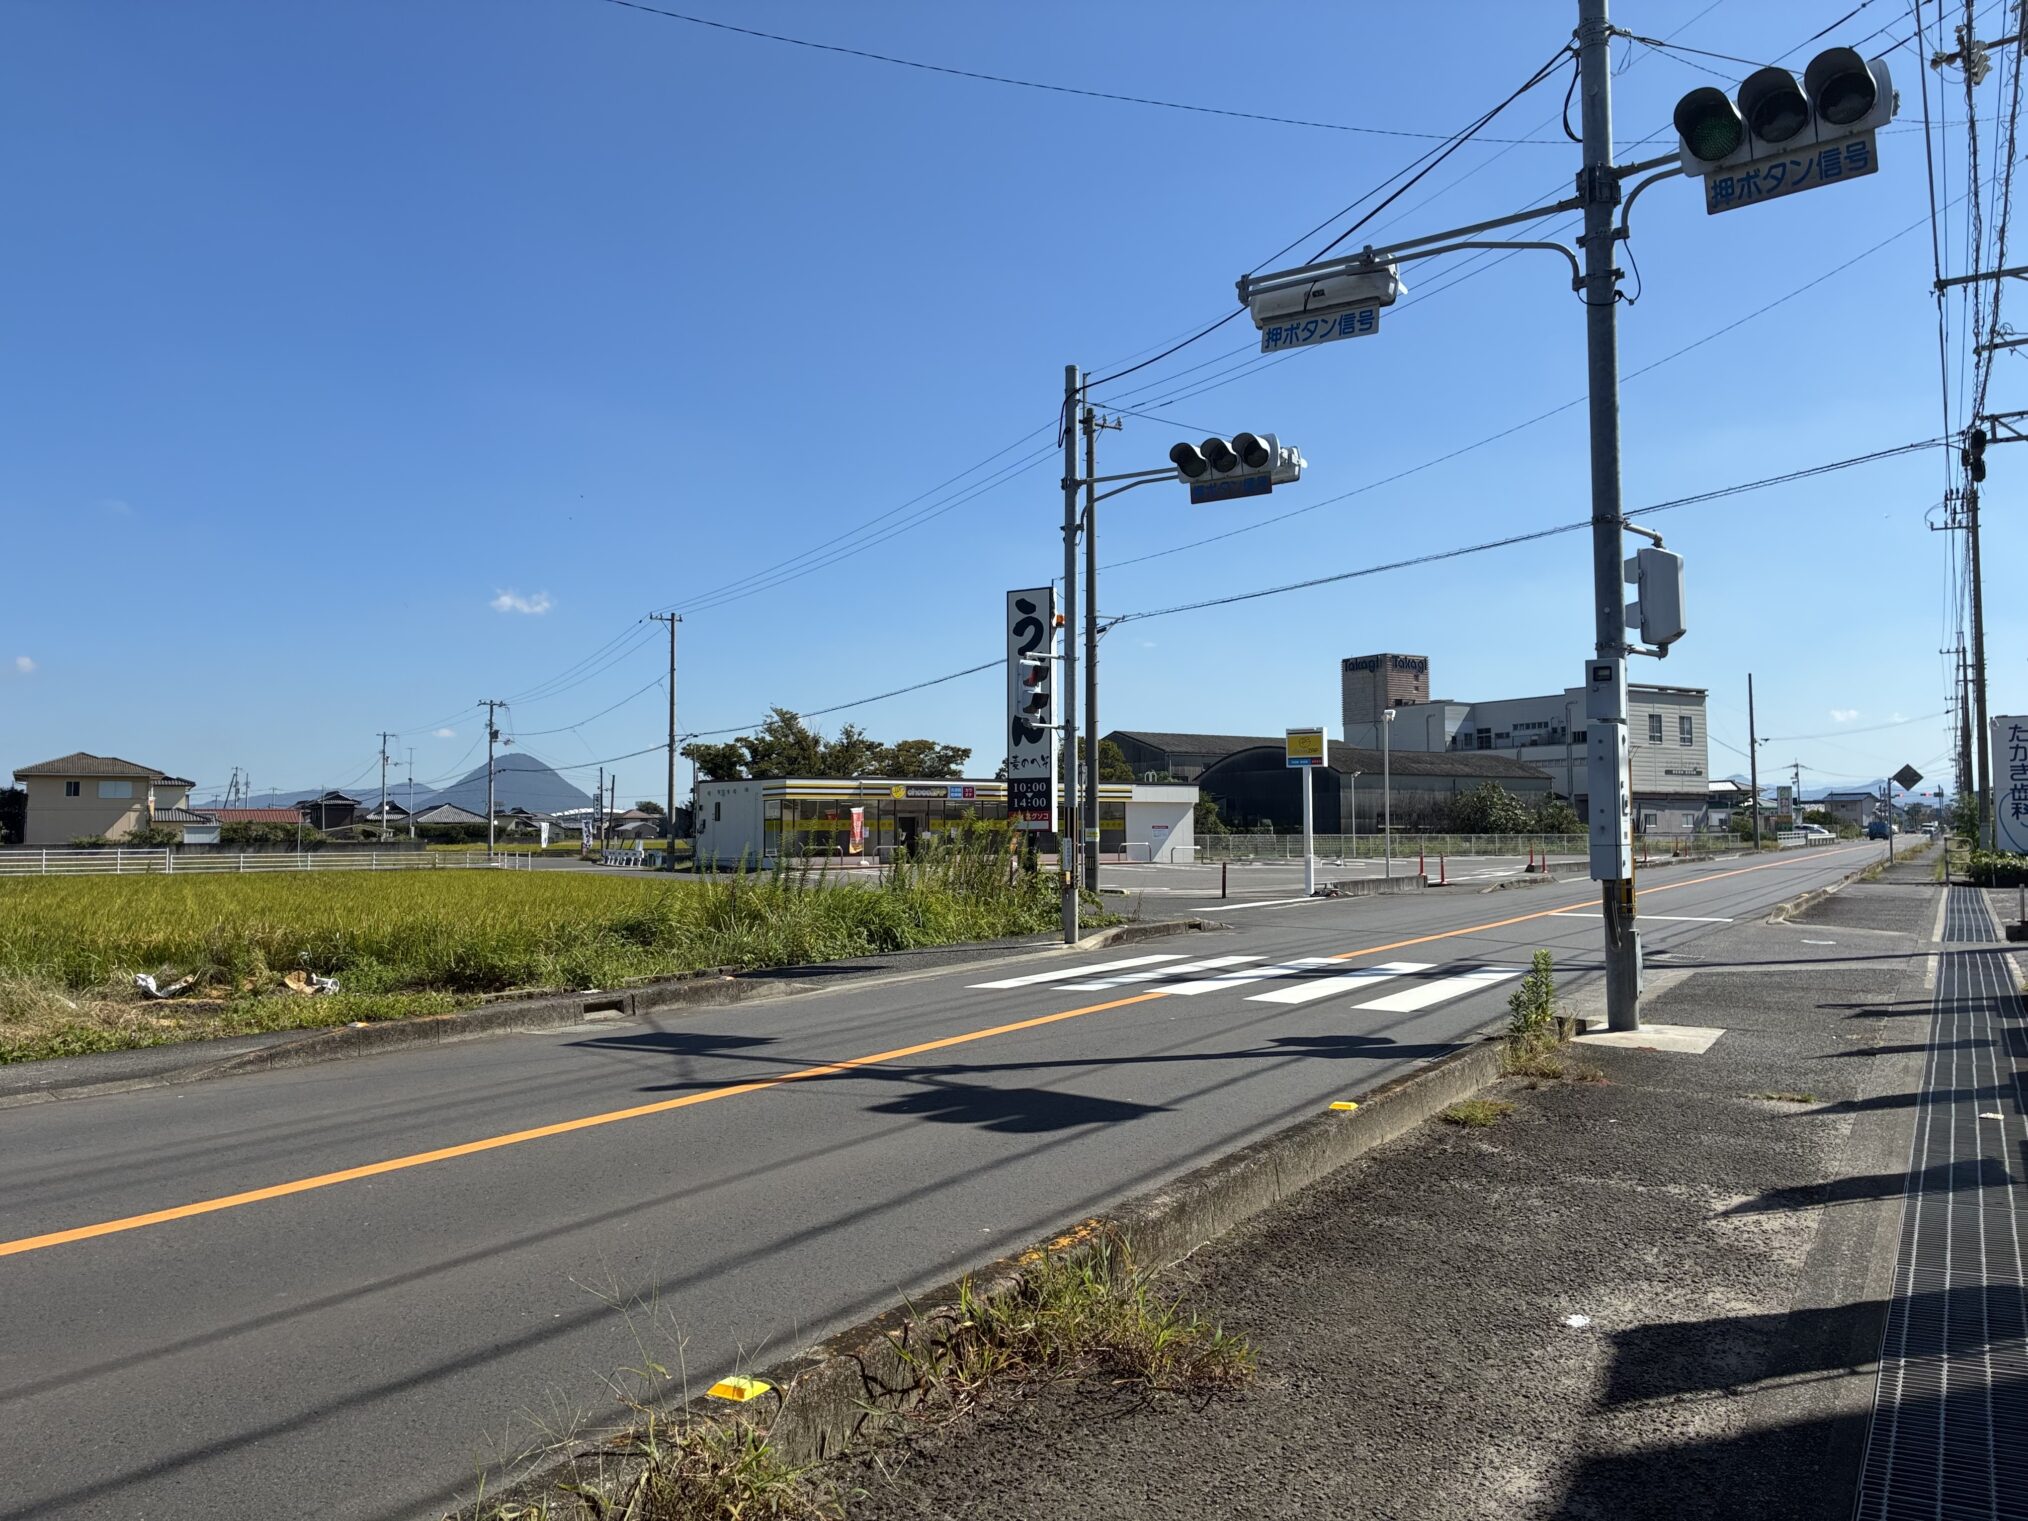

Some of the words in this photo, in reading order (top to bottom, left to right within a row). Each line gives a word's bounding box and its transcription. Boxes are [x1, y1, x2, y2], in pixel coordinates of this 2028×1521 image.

[1710, 140, 1870, 209] 押ボタン信号
[1265, 309, 1375, 349] 押ボタン信号
[1012, 598, 1046, 747] うん
[1343, 656, 1379, 673] Takagi
[1393, 656, 1427, 673] Takagi
[1013, 782, 1046, 793] 10:00
[1013, 797, 1046, 808] 14:00
